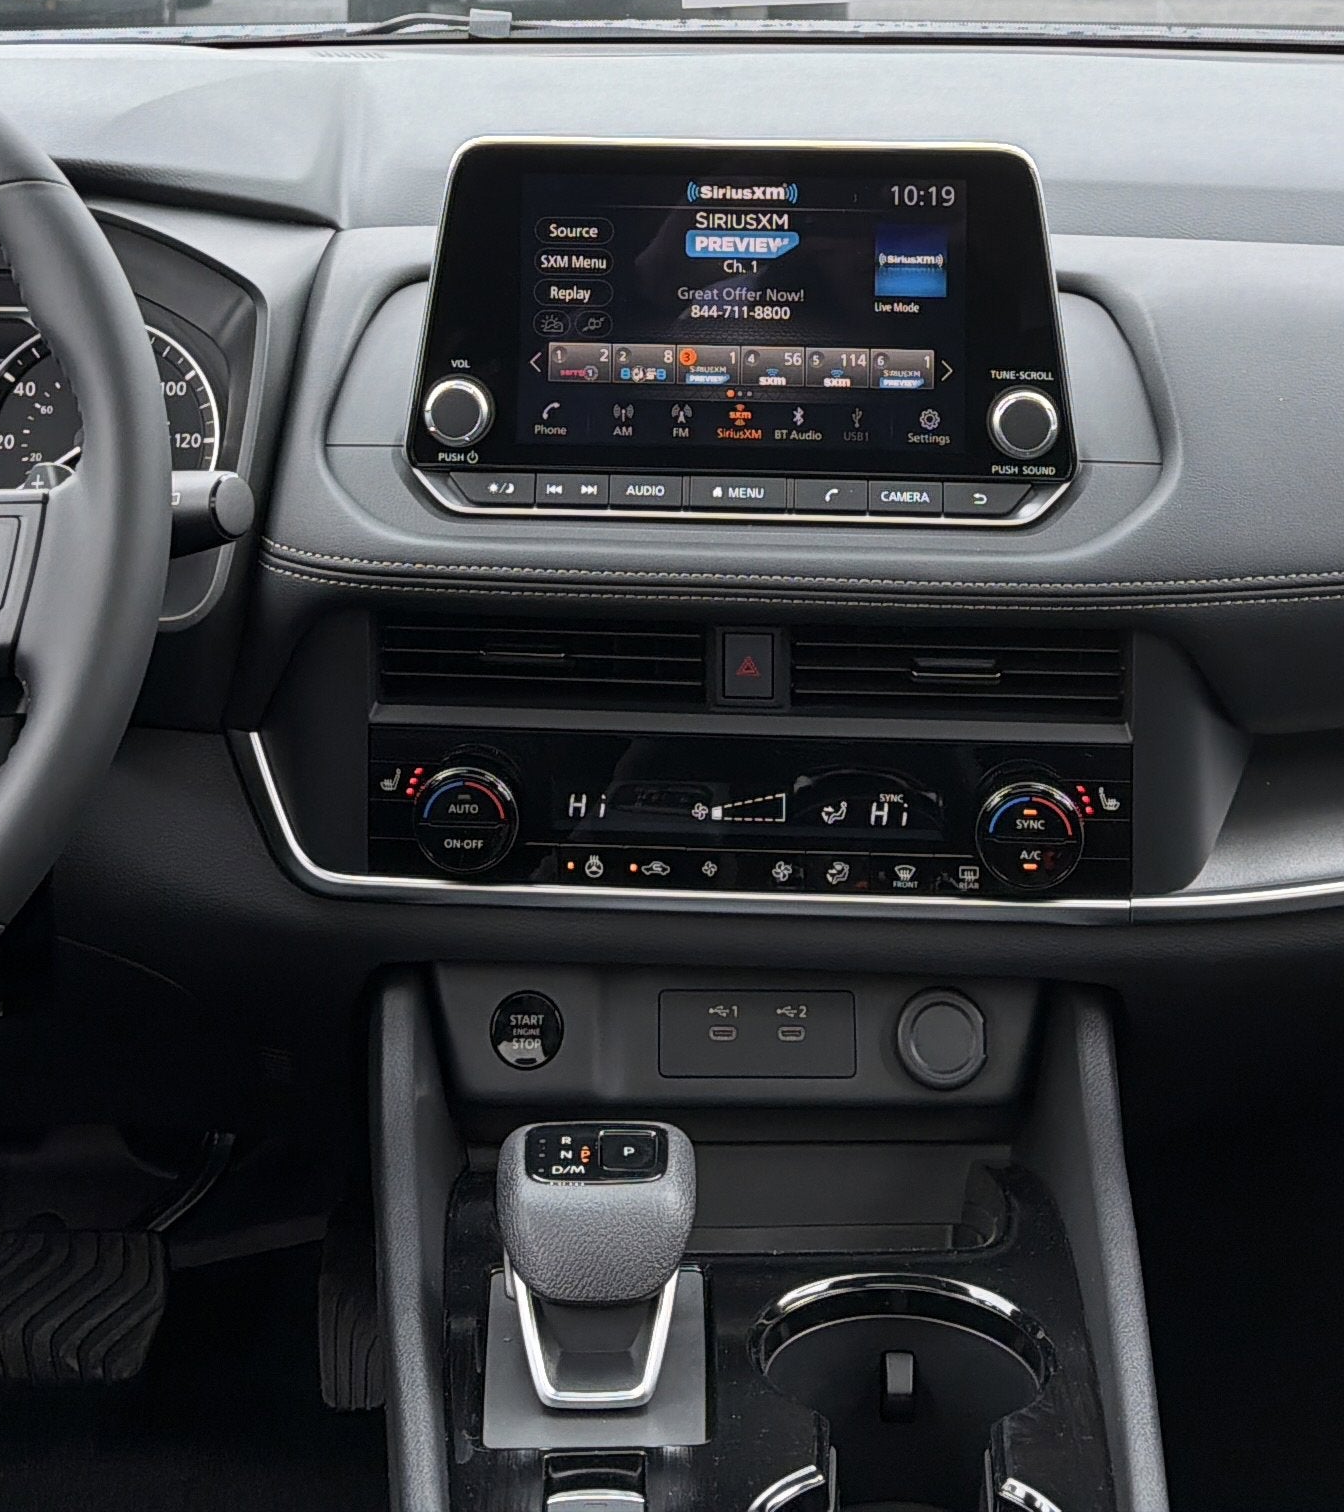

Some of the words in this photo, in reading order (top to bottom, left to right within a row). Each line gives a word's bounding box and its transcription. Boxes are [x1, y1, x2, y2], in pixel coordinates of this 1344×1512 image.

[890, 186, 955, 206] 10:19
[696, 212, 789, 230] SIRIUSXM
[549, 224, 599, 238] Source
[541, 255, 569, 268] SXM
[571, 256, 607, 270] Menu
[723, 260, 747, 274] Ch.
[751, 261, 758, 273] 1
[550, 286, 591, 303] Replay
[677, 287, 719, 301] Great
[722, 287, 762, 302] Offer
[766, 288, 804, 302] Now!
[690, 305, 791, 319] 844-711-8800
[874, 302, 891, 313] Live
[893, 303, 920, 314] Mode
[599, 349, 609, 362] 2
[619, 352, 627, 362] 2
[664, 350, 673, 363] 8
[684, 352, 691, 362] 3
[729, 351, 736, 365] 1
[747, 353, 755, 364] 4
[784, 352, 802, 367] 56
[812, 354, 820, 366] 5
[840, 353, 867, 367] 114
[877, 355, 884, 367] 6
[451, 359, 471, 368] VOL
[924, 355, 931, 369] 1
[13, 381, 36, 397] 40
[160, 381, 187, 396] 100
[40, 406, 54, 415] 60
[534, 425, 567, 436] Phone
[613, 427, 632, 436] AM
[673, 428, 689, 437] FM
[717, 429, 762, 440] SiriusXM
[775, 431, 788, 440] BT
[790, 430, 822, 440] Audio
[174, 433, 202, 448] 120
[844, 432, 869, 442] USB1
[908, 433, 950, 445] Settings
[30, 453, 42, 462] 20
[438, 453, 464, 462] PUSH
[991, 465, 1018, 475] PUSH
[1022, 465, 1056, 476] SOUND
[626, 485, 665, 496] AUDIO
[728, 487, 764, 499] MENU
[881, 491, 930, 503] CAMERA
[879, 794, 904, 803] SYNC
[448, 804, 479, 814] AUTO
[568, 793, 606, 818] Hi
[870, 802, 908, 826] Hi
[1016, 819, 1045, 830] SYNC
[1020, 850, 1042, 860] A/C
[893, 880, 919, 888] FRONT
[959, 881, 980, 889] REAR
[732, 1006, 738, 1017] 1
[799, 1006, 807, 1017] 2
[510, 1014, 544, 1026] START
[513, 1027, 540, 1036] ENGINE
[512, 1038, 542, 1050] STOP
[561, 1136, 572, 1145] R
[560, 1150, 572, 1159] N
[581, 1149, 590, 1158] P
[623, 1147, 635, 1157] P
[551, 1165, 585, 1175] D/M
